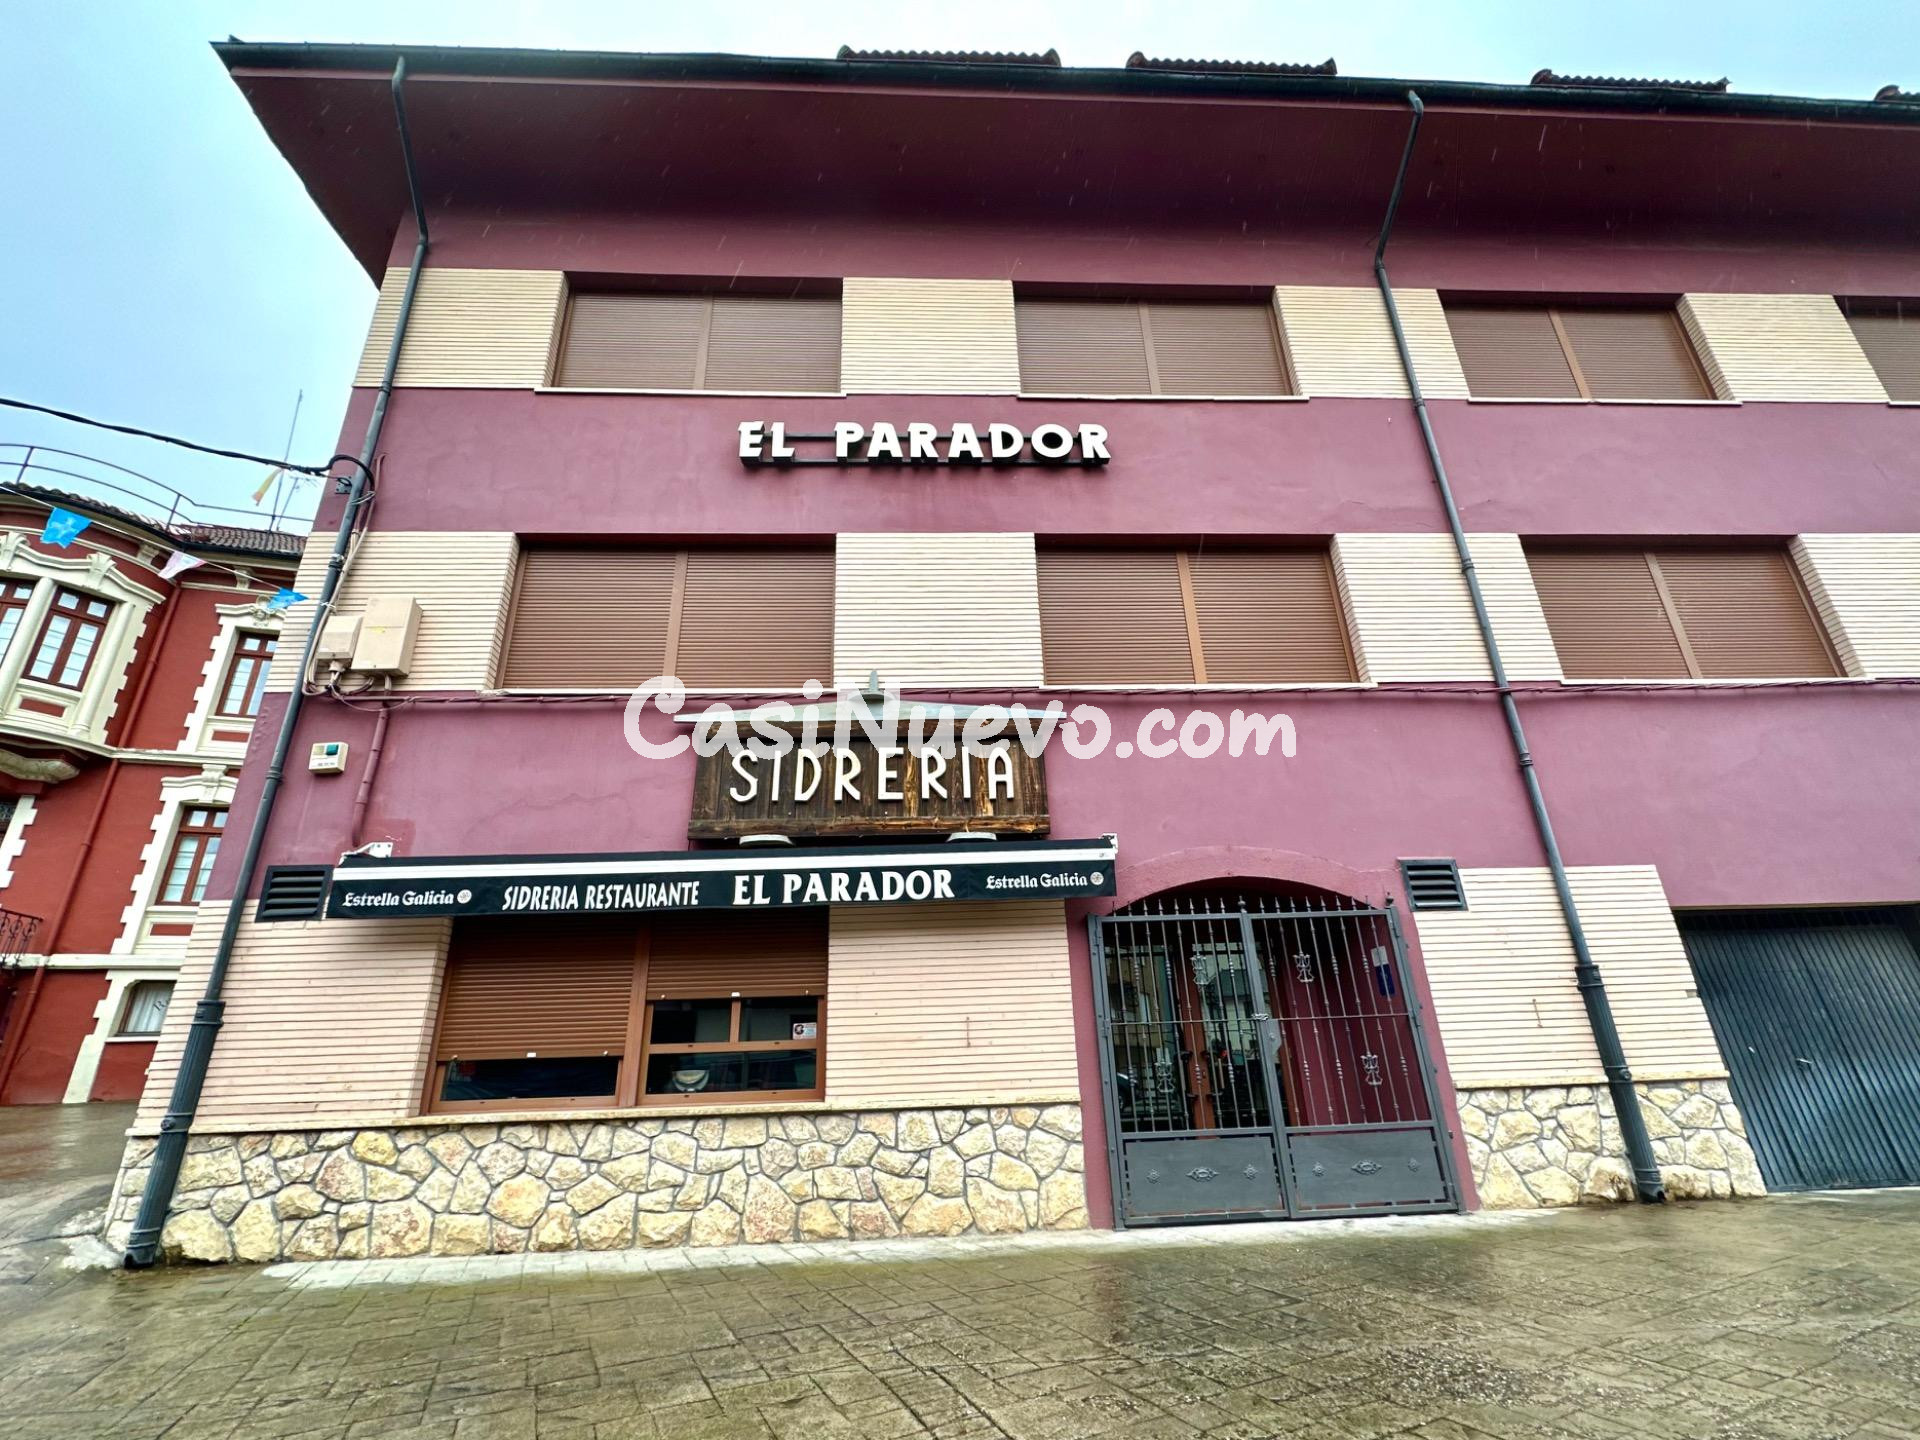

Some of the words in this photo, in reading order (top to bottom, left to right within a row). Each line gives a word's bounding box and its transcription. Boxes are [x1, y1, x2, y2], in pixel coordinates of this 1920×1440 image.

[737, 420, 795, 459] EL
[834, 421, 1112, 460] PARADOR
[729, 746, 1015, 803] SIDRERIA
[342, 891, 399, 907] Estrella
[402, 889, 454, 906] Galicia
[502, 884, 579, 911] SIDRERIA
[584, 880, 700, 910] RESTAURANTE
[733, 874, 770, 906] EL
[782, 869, 955, 904] PARADOR
[985, 874, 1038, 890] Estrella
[1040, 872, 1088, 888] Galicia
